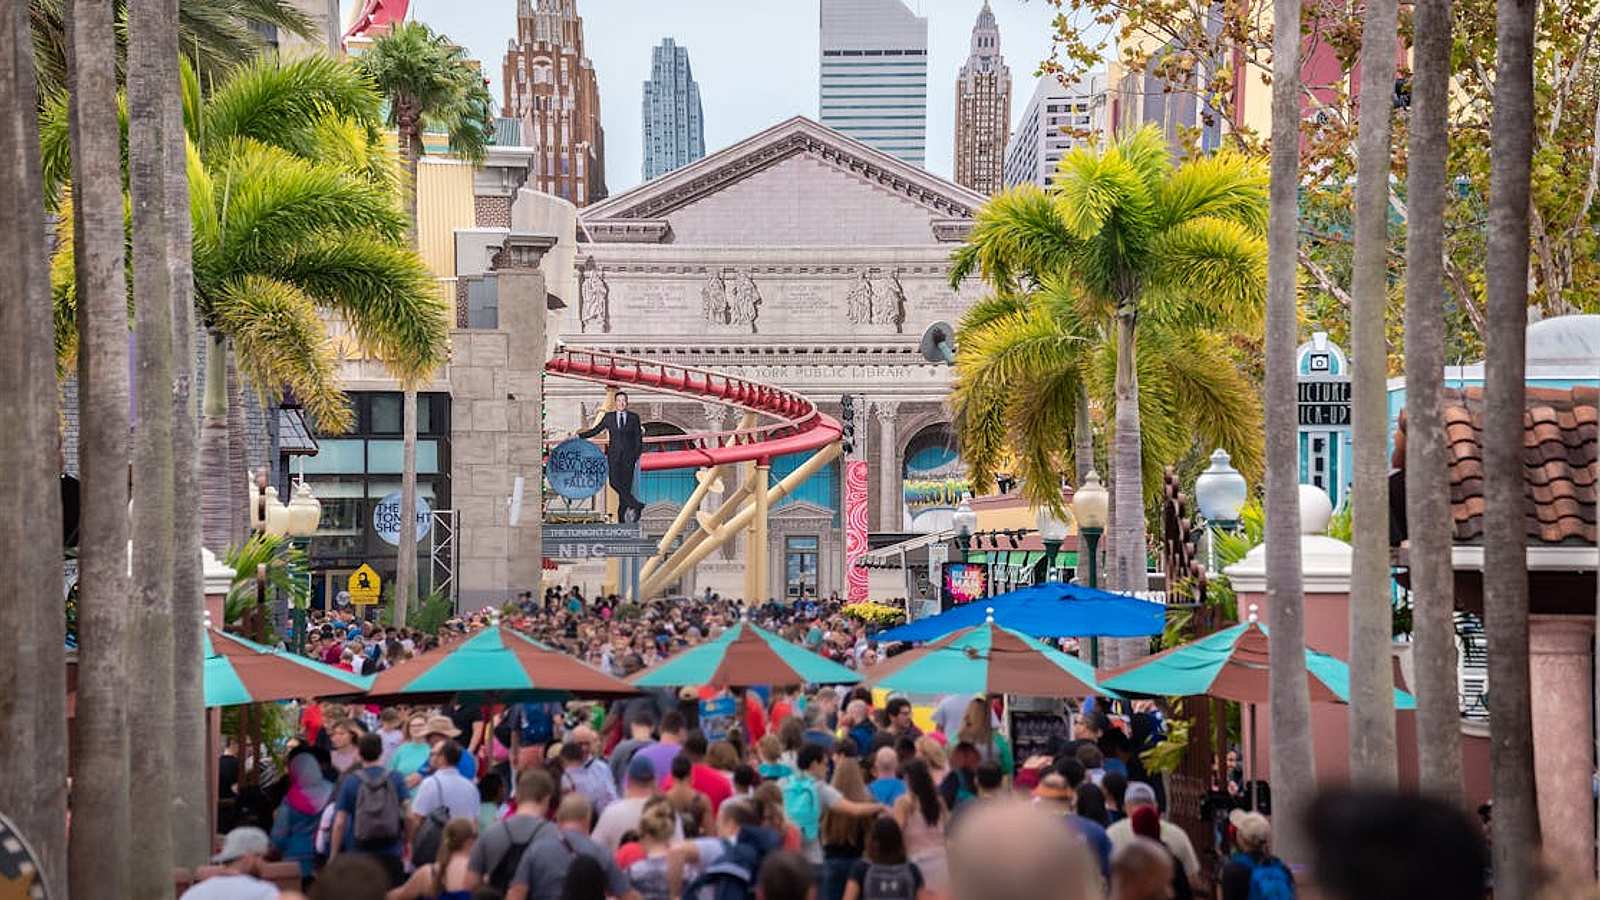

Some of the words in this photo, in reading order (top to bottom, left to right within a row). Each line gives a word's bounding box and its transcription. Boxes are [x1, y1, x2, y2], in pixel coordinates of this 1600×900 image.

[754, 367, 788, 377] YORK
[795, 367, 846, 378] PUBLIC
[852, 367, 913, 378] LIBRARY
[1301, 383, 1351, 401] ICTURE
[1301, 406, 1347, 424] ICK-UP
[377, 503, 399, 512] THE
[376, 512, 431, 523] TONHT
[376, 521, 401, 533] SHO
[559, 543, 606, 557] NBC
